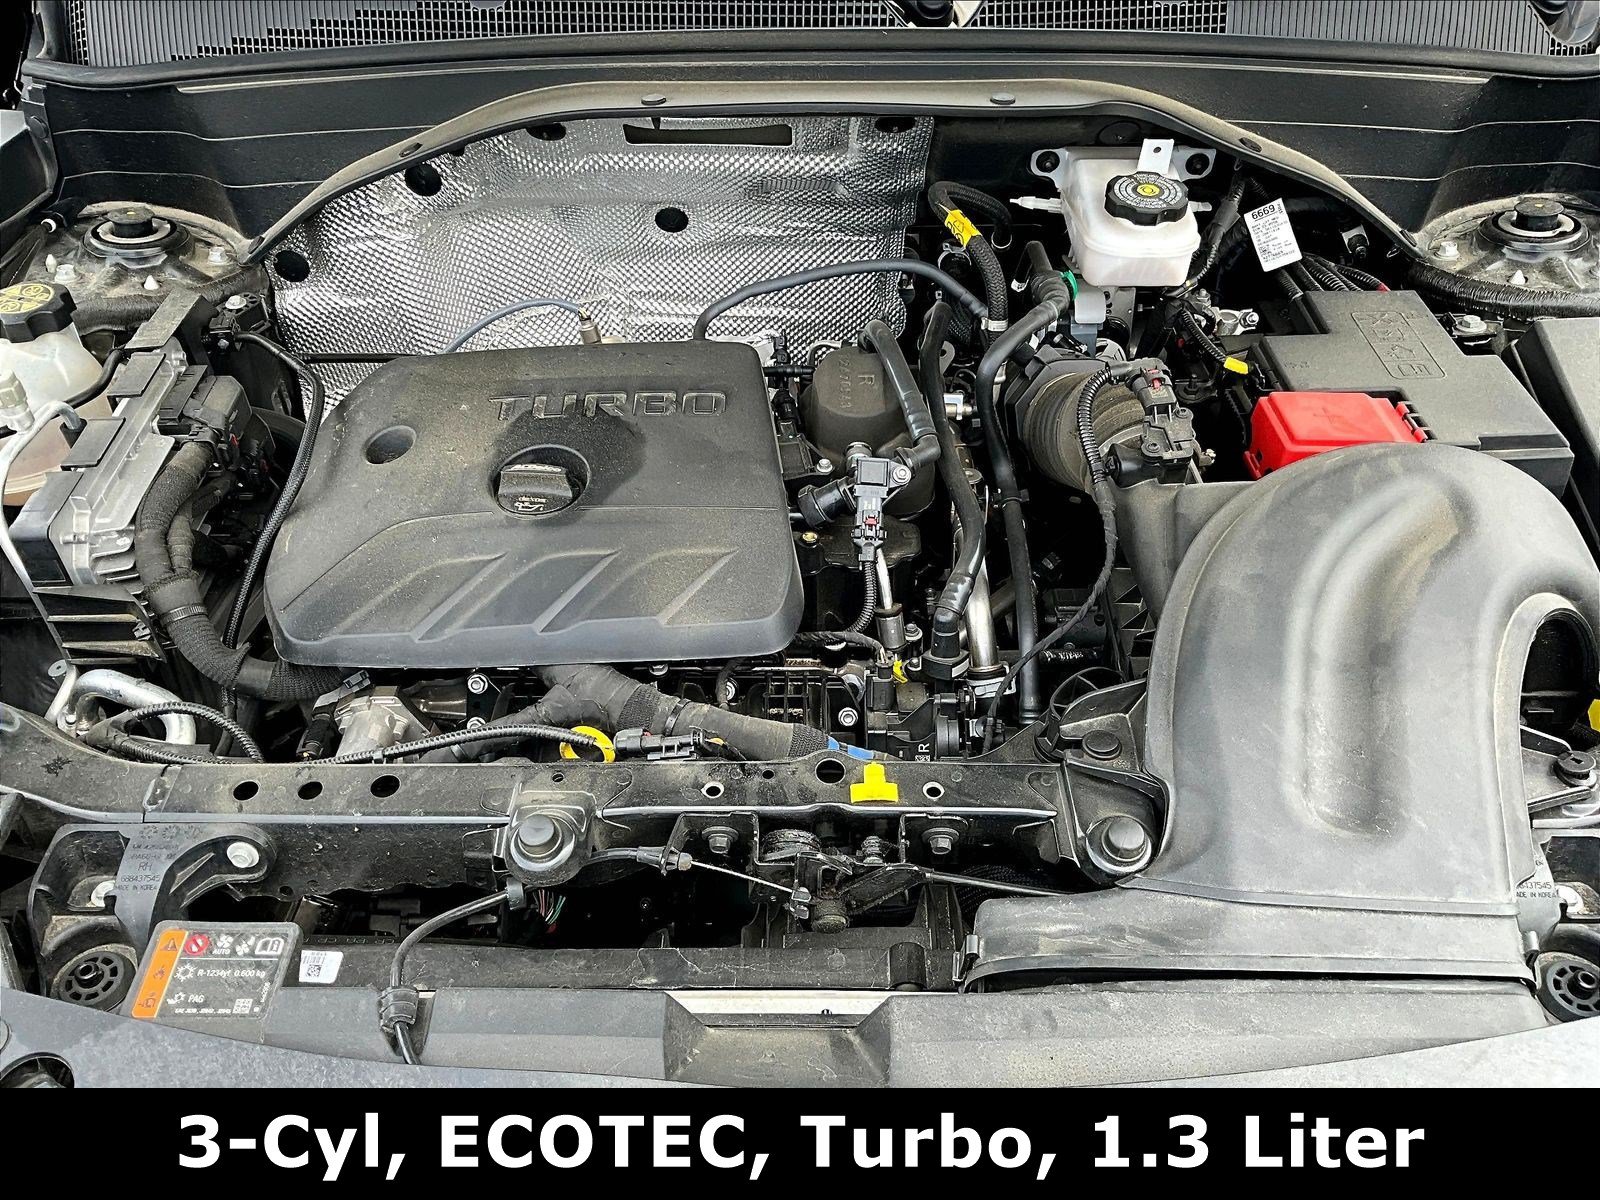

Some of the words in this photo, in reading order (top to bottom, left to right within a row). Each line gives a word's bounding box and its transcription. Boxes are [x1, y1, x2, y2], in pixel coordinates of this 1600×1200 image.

[1251, 204, 1276, 219] 6669
[488, 390, 726, 421] TURBO
[197, 969, 230, 978] R-1234yf
[234, 969, 255, 977] 0.600
[255, 969, 266, 979] kg
[187, 994, 205, 1003] PAG
